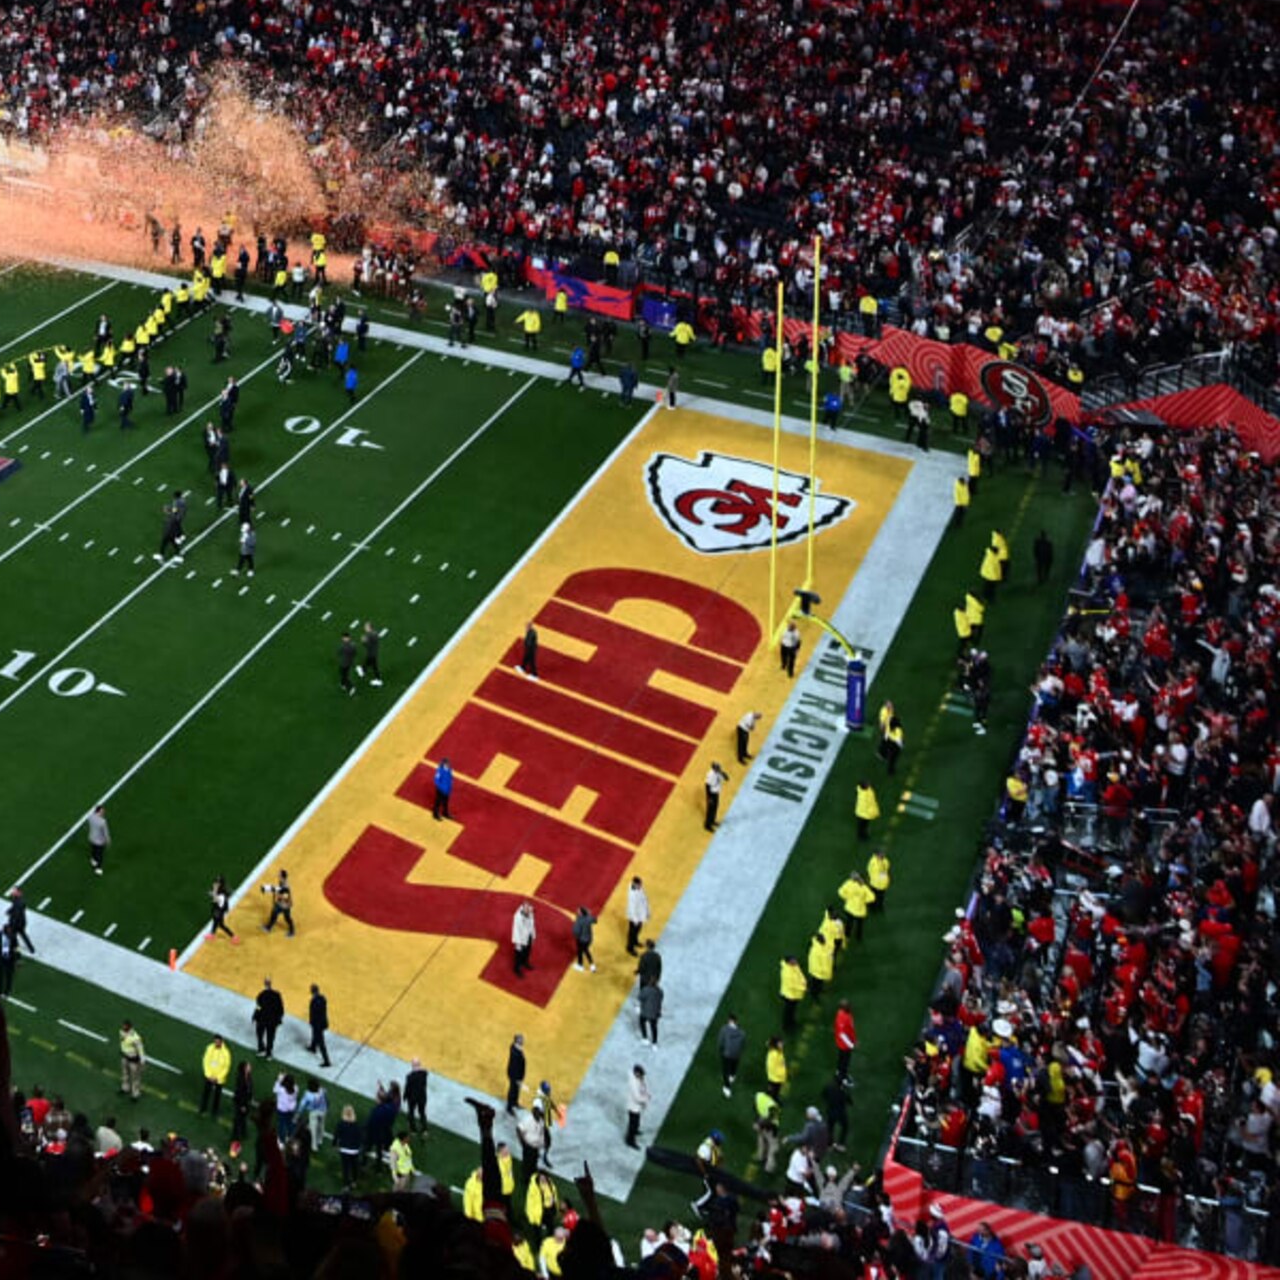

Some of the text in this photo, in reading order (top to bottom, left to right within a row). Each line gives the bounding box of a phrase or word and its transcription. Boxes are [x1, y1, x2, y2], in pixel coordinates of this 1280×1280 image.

[673, 478, 803, 537] KC
[323, 566, 762, 1010] CHIEFS
[753, 692, 848, 804] RACISM
